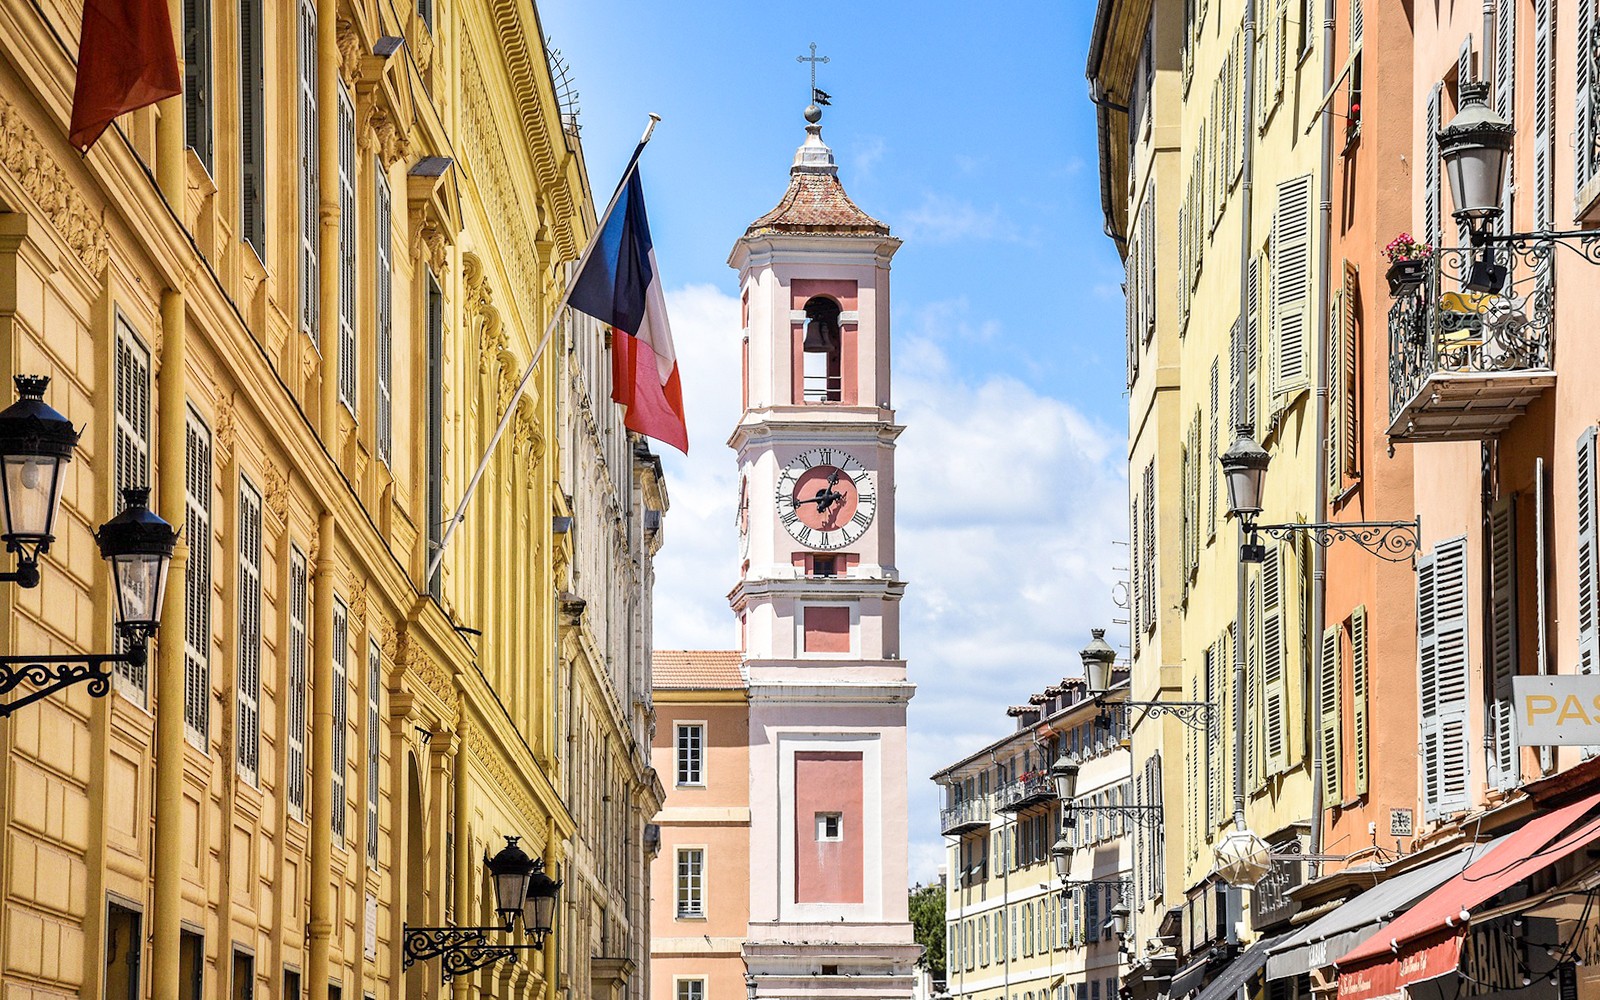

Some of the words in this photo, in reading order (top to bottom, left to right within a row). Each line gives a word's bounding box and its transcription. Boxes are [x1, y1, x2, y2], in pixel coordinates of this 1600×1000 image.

[799, 456, 812, 469] XI
[820, 451, 832, 465] XII
[841, 457, 850, 470] I
[783, 471, 798, 485] X
[853, 473, 866, 483] II
[859, 494, 872, 502] III
[851, 510, 868, 527] IIII
[799, 525, 811, 540] VII
[821, 532, 829, 545] VI
[842, 527, 852, 541] V
[1525, 694, 1600, 726] PA
